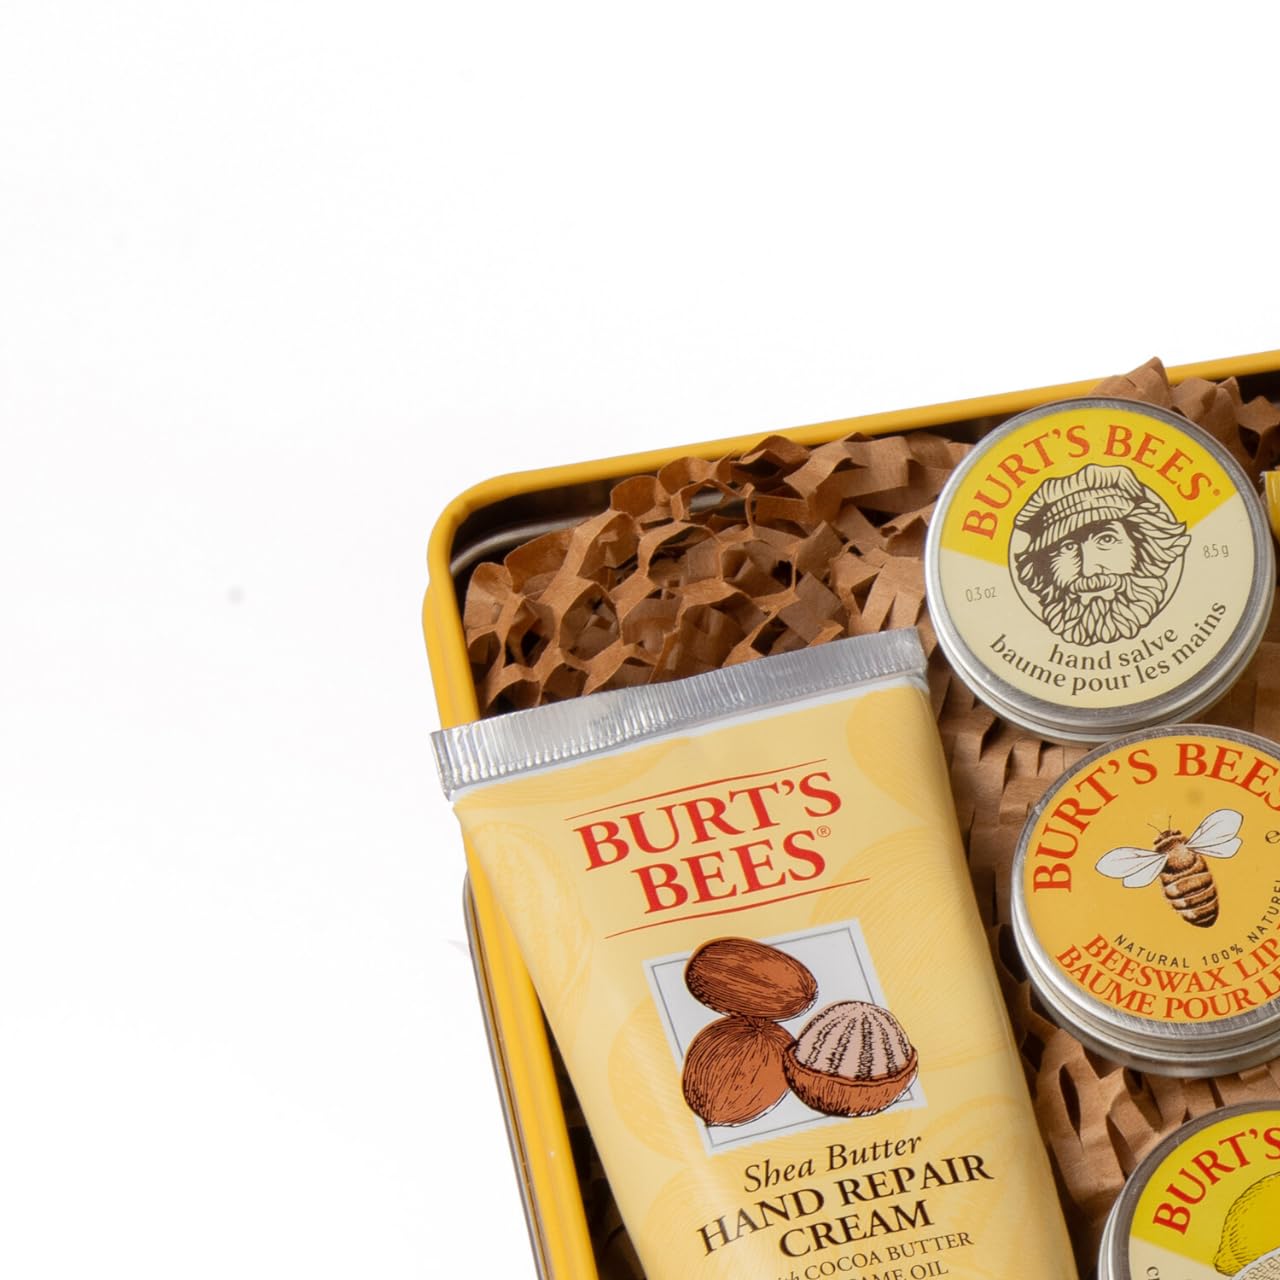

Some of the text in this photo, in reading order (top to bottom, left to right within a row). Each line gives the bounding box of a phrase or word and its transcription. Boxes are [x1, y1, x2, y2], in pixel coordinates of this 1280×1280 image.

[962, 424, 1213, 540] BURT'S BEES
[1203, 544, 1219, 560] 8.5
[966, 586, 998, 602] 0.3 oz
[989, 600, 1227, 695] baume pour les mains
[1048, 627, 1178, 671] hand salve
[573, 771, 842, 872] BURT'S
[1033, 749, 1158, 892] BURT'S
[1081, 934, 1233, 994] BEESWAX
[1232, 937, 1280, 979] LIP
[1114, 934, 1190, 968] NATURAL
[1202, 943, 1244, 966] 100%
[1055, 944, 1156, 1016] BAUME
[1162, 986, 1258, 1020] POUR
[744, 1136, 922, 1193] Shea Butter
[697, 1153, 995, 1257] HAND REPAIR
[780, 1200, 935, 1258] CREAM
[804, 1250, 882, 1280] COCOA
[888, 1231, 974, 1261] BUTTER
[910, 1259, 949, 1279] OIL
